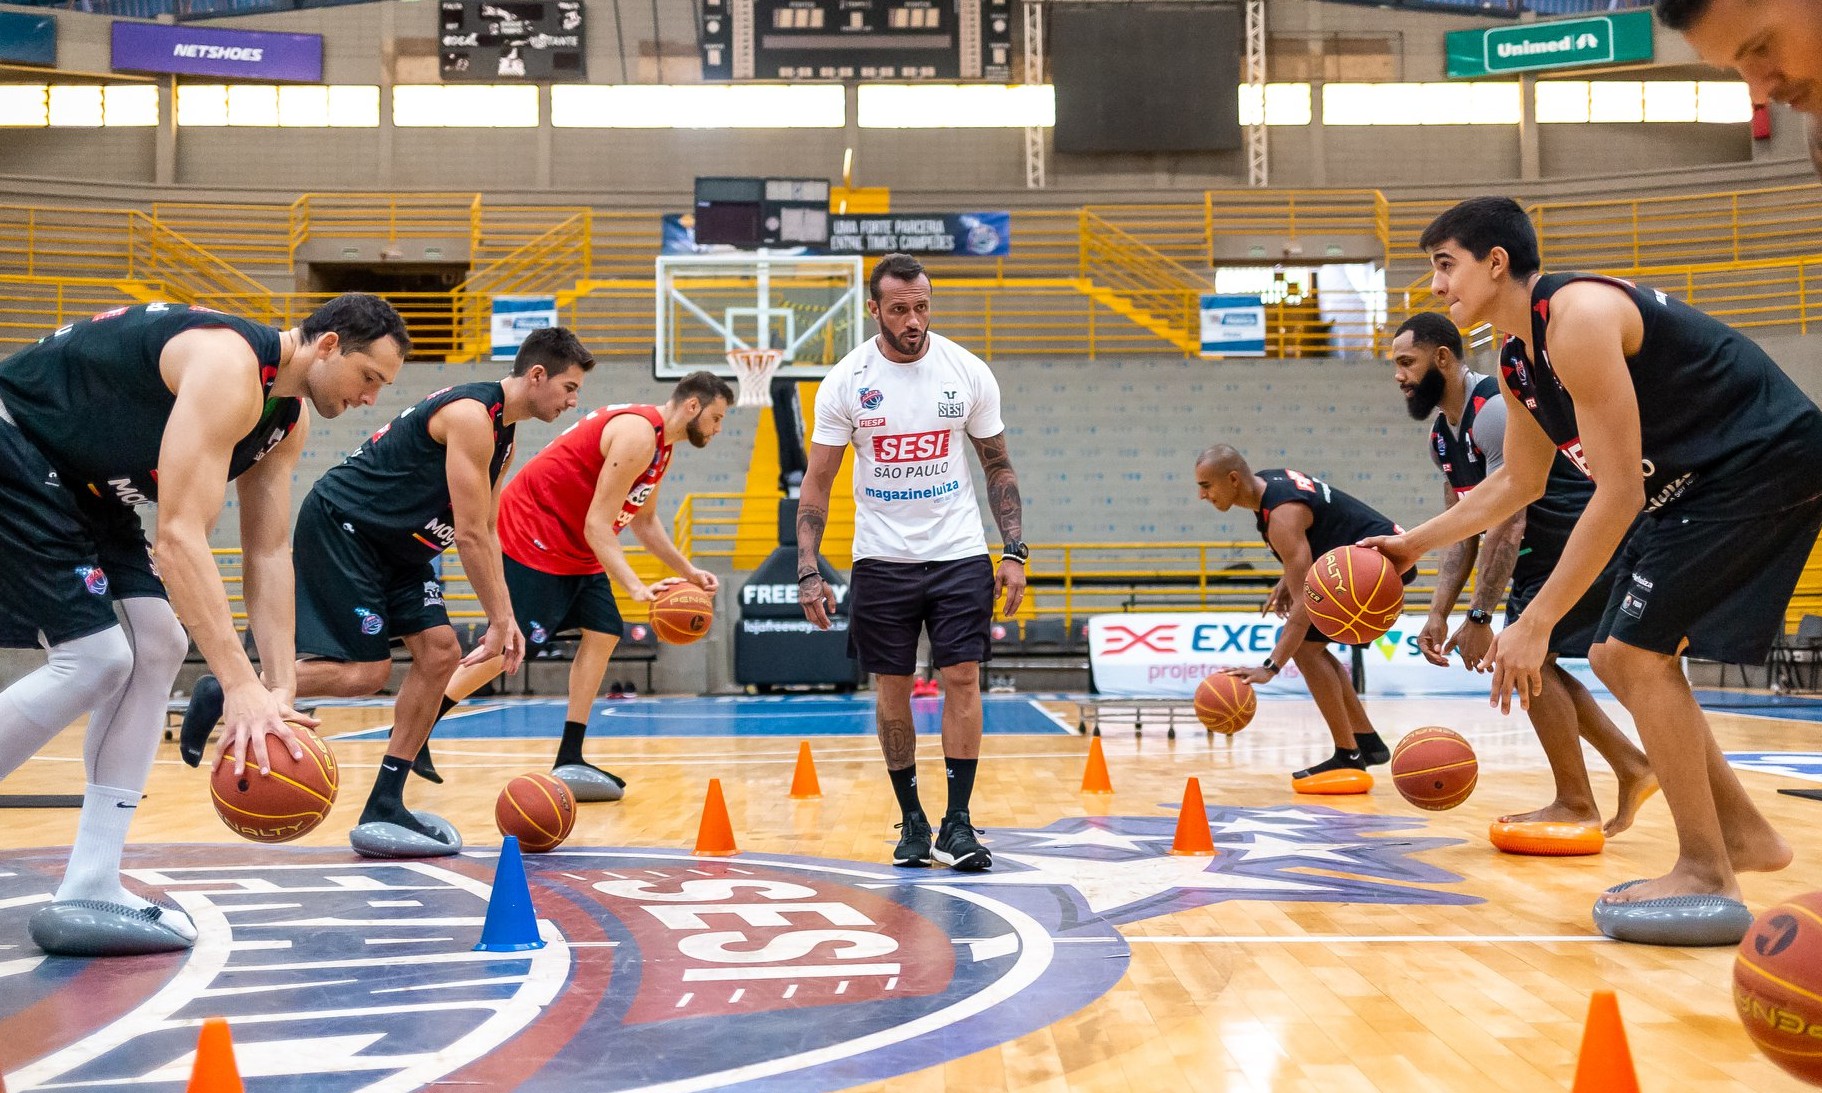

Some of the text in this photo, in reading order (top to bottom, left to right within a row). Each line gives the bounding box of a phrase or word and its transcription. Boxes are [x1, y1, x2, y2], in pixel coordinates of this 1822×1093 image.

[173, 43, 264, 62] NETSHOES
[1497, 35, 1571, 58] Unimed
[860, 220, 890, 235] FORTE
[894, 220, 945, 235] PARCERIA
[830, 235, 863, 250] ENTRE
[867, 235, 898, 250] TIMES
[938, 401, 964, 418] SESI
[860, 418, 885, 428] FIESP
[880, 433, 945, 461] SESI
[874, 462, 949, 479] SÃO PAULO
[107, 478, 149, 506] Ma
[865, 480, 960, 502] magazineluiza
[743, 584, 848, 604] FREEY
[591, 879, 901, 982] SESI
